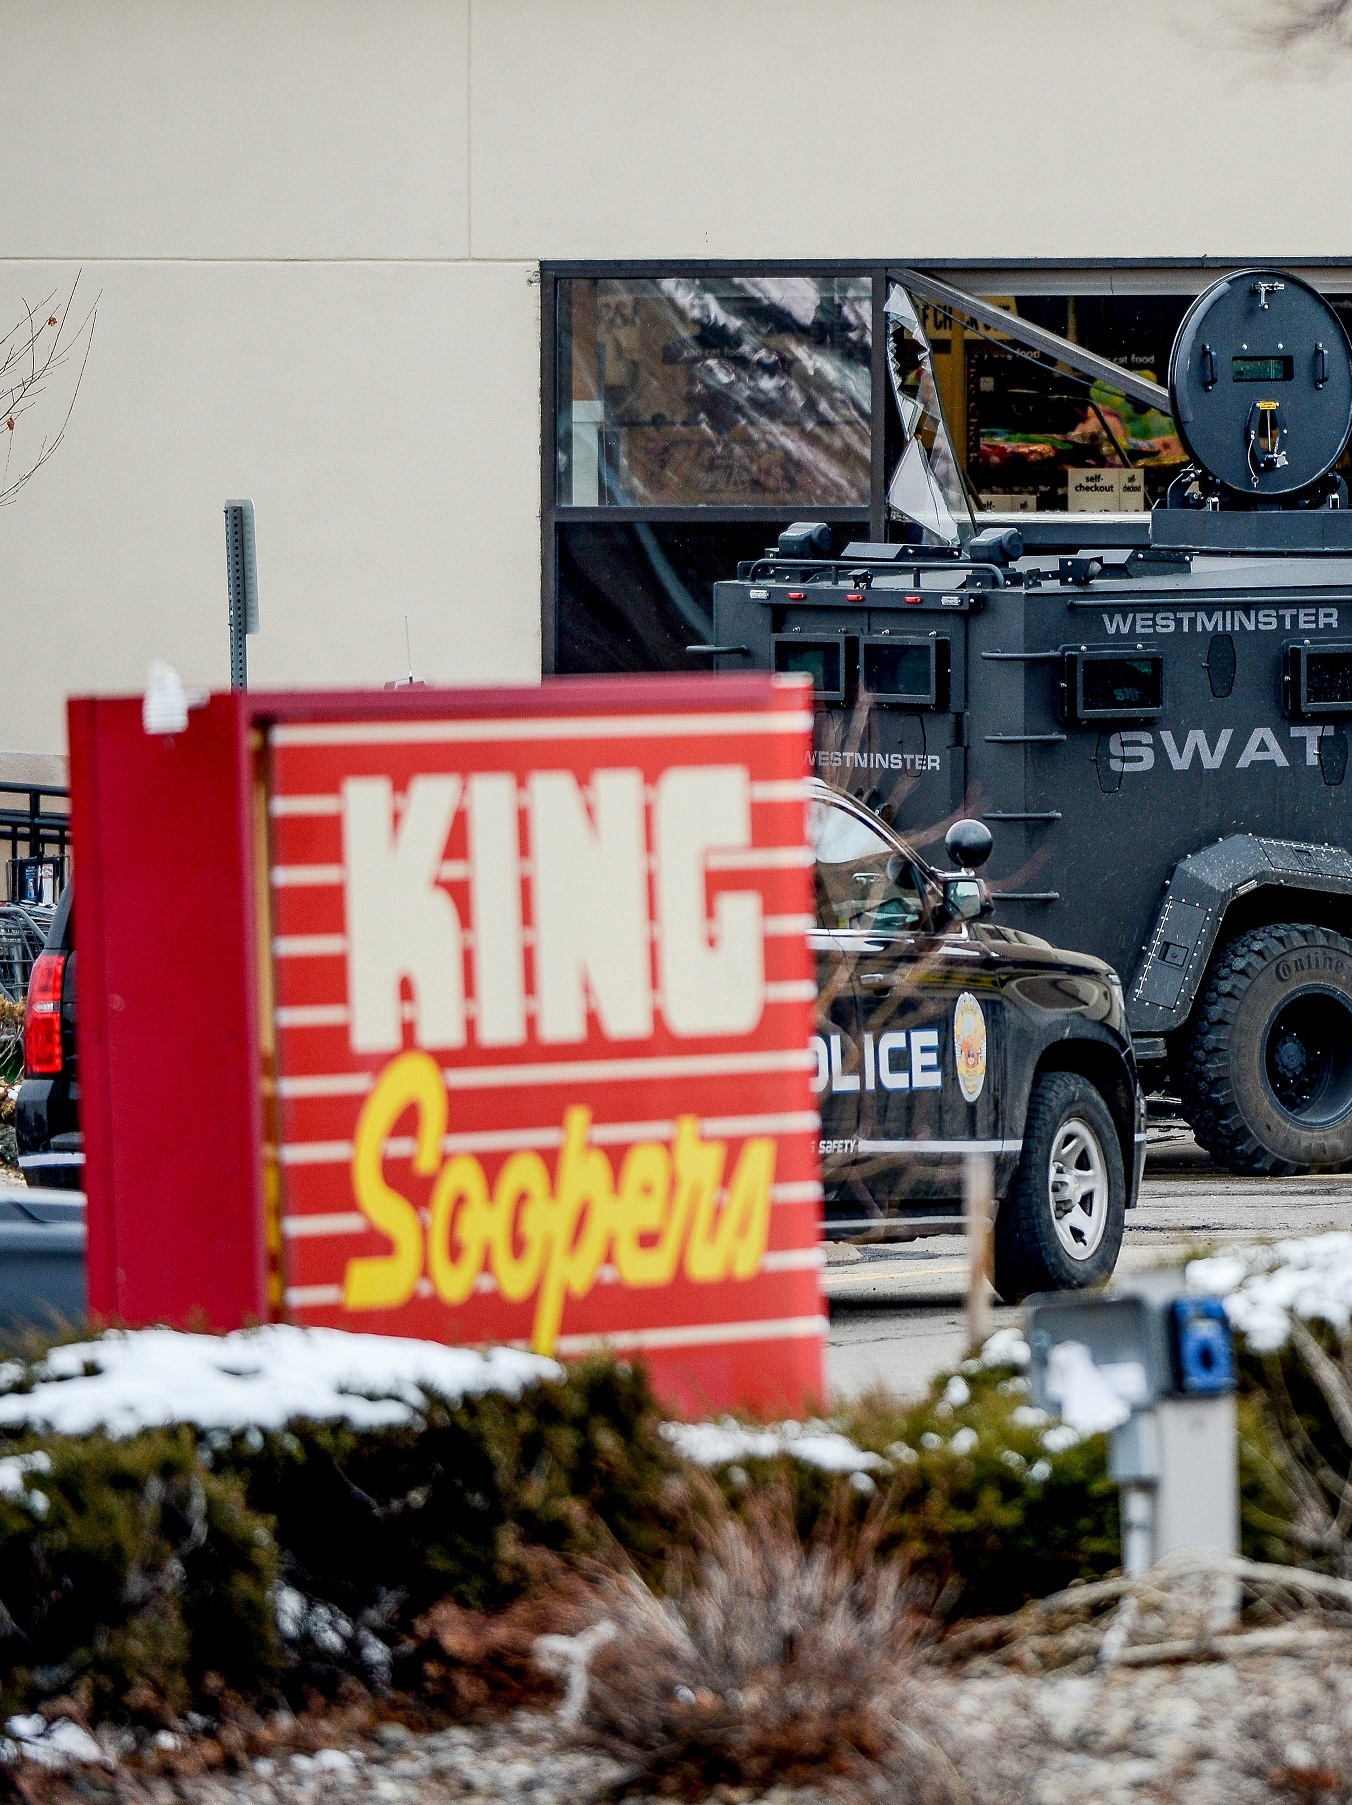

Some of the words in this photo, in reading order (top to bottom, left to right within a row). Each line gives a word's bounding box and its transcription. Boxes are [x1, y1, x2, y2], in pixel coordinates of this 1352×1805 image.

[1131, 354, 1155, 364] food
[1075, 483, 1114, 492] checkout
[1085, 474, 1104, 483] self-
[1102, 607, 1339, 635] WESTMINSTER
[1109, 725, 1335, 773] SWAT
[341, 766, 765, 1055] KING
[343, 1050, 778, 1358] Soopers
